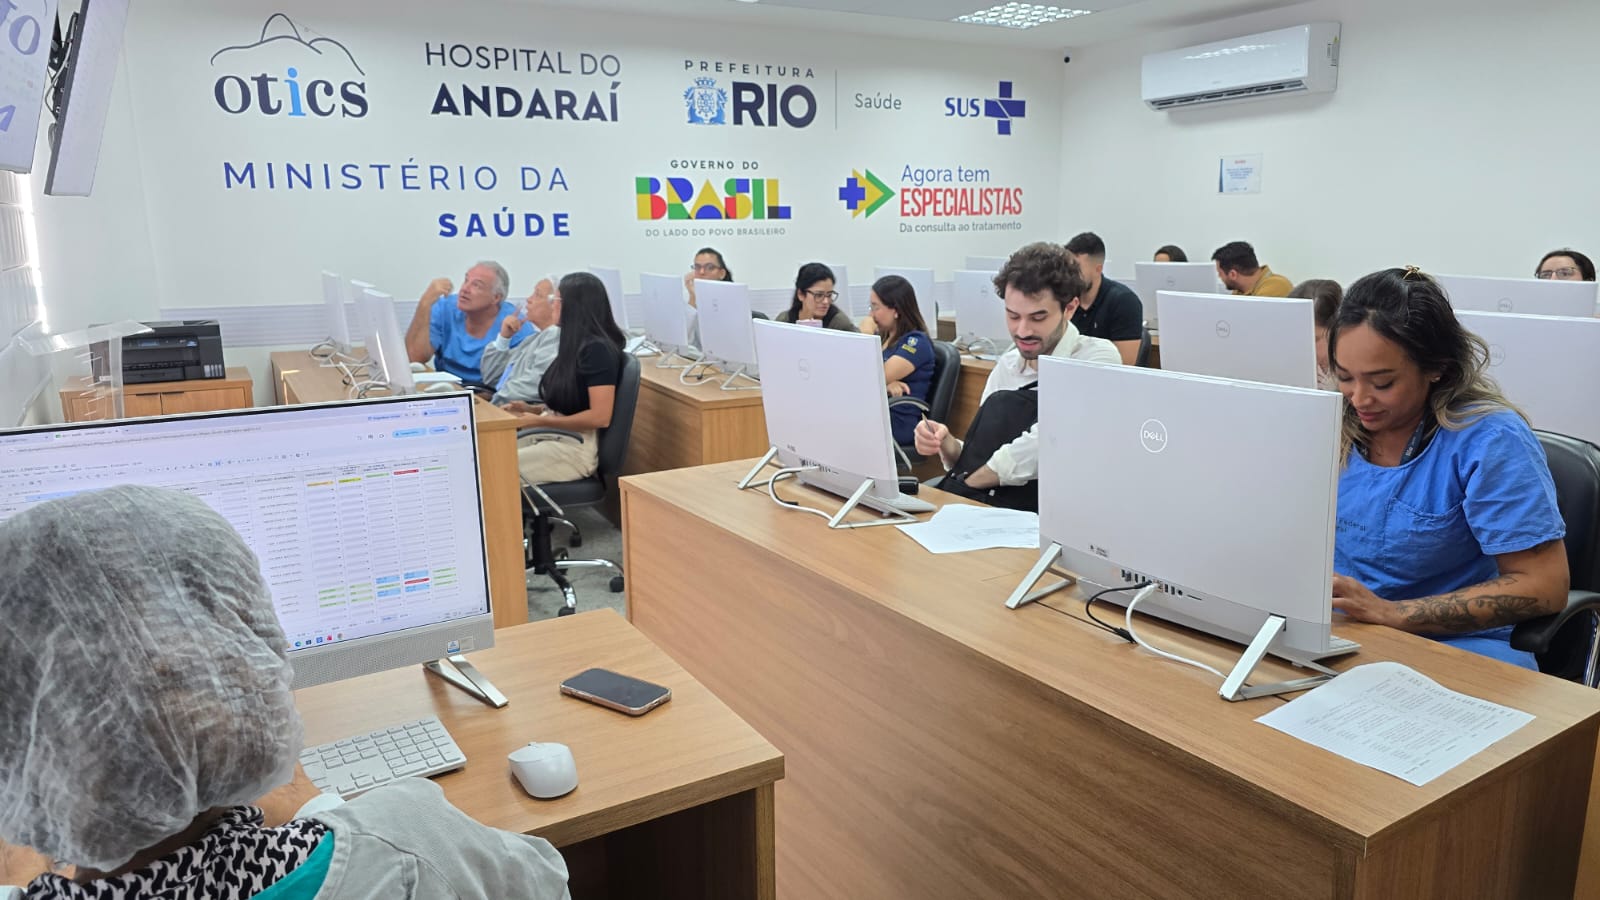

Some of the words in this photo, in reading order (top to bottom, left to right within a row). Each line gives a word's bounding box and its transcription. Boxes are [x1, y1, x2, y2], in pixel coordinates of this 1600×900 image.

[425, 42, 572, 75] HOSPITAL
[580, 53, 621, 77] DO
[684, 60, 815, 78] PREFEITURA
[214, 67, 369, 118] otics
[431, 82, 621, 122] ANDARAÍ
[732, 81, 817, 128] RIO
[854, 92, 902, 110] Saúde
[945, 97, 980, 117] SUS
[223, 158, 498, 191] MINISTÉRIO
[520, 166, 569, 191] DA
[670, 159, 735, 170] GOVERNO
[743, 160, 759, 170] DO
[901, 164, 953, 186] Agora
[957, 165, 990, 182] tem
[635, 176, 792, 220] BRASIL
[900, 187, 1023, 217] ESPECIALISTAS
[438, 207, 570, 238] SAÚDE
[645, 229, 660, 237] DO
[663, 228, 689, 237] LADO
[691, 228, 706, 237] DO
[708, 227, 735, 237] POVO
[736, 227, 786, 236] BRASILEIRO
[900, 223, 913, 233] Da
[914, 221, 957, 233] consulta
[958, 224, 970, 232] ao
[971, 220, 1022, 232] tratamento
[1143, 430, 1164, 442] DELL
